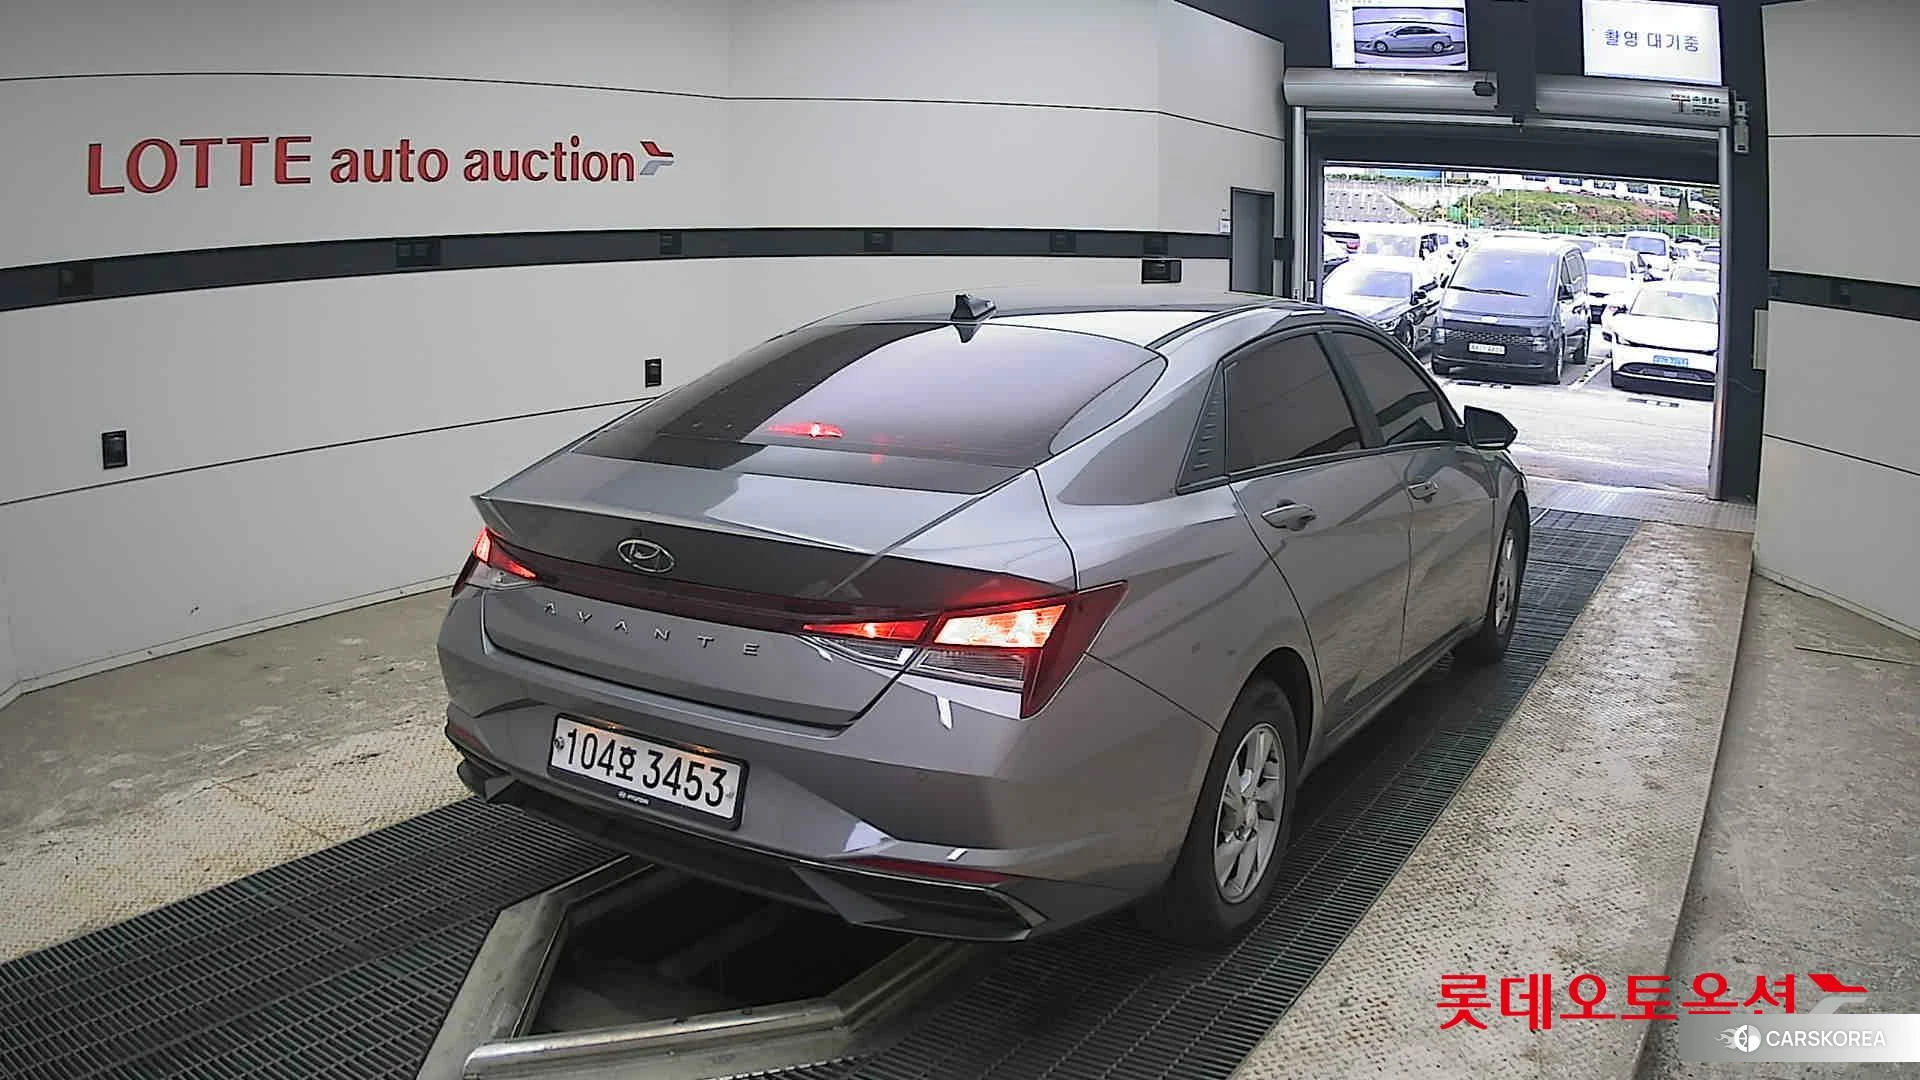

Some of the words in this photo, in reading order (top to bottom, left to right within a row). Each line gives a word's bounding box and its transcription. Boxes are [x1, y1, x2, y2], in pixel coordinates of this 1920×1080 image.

[1604, 29, 1638, 47] 촬영
[1647, 32, 1699, 52] 대기중
[88, 136, 311, 195] LOTTE
[330, 139, 449, 183] auto
[463, 135, 635, 182] auction
[544, 602, 760, 656] AVANTE
[568, 728, 637, 781] 104호
[643, 750, 727, 807] 3453
